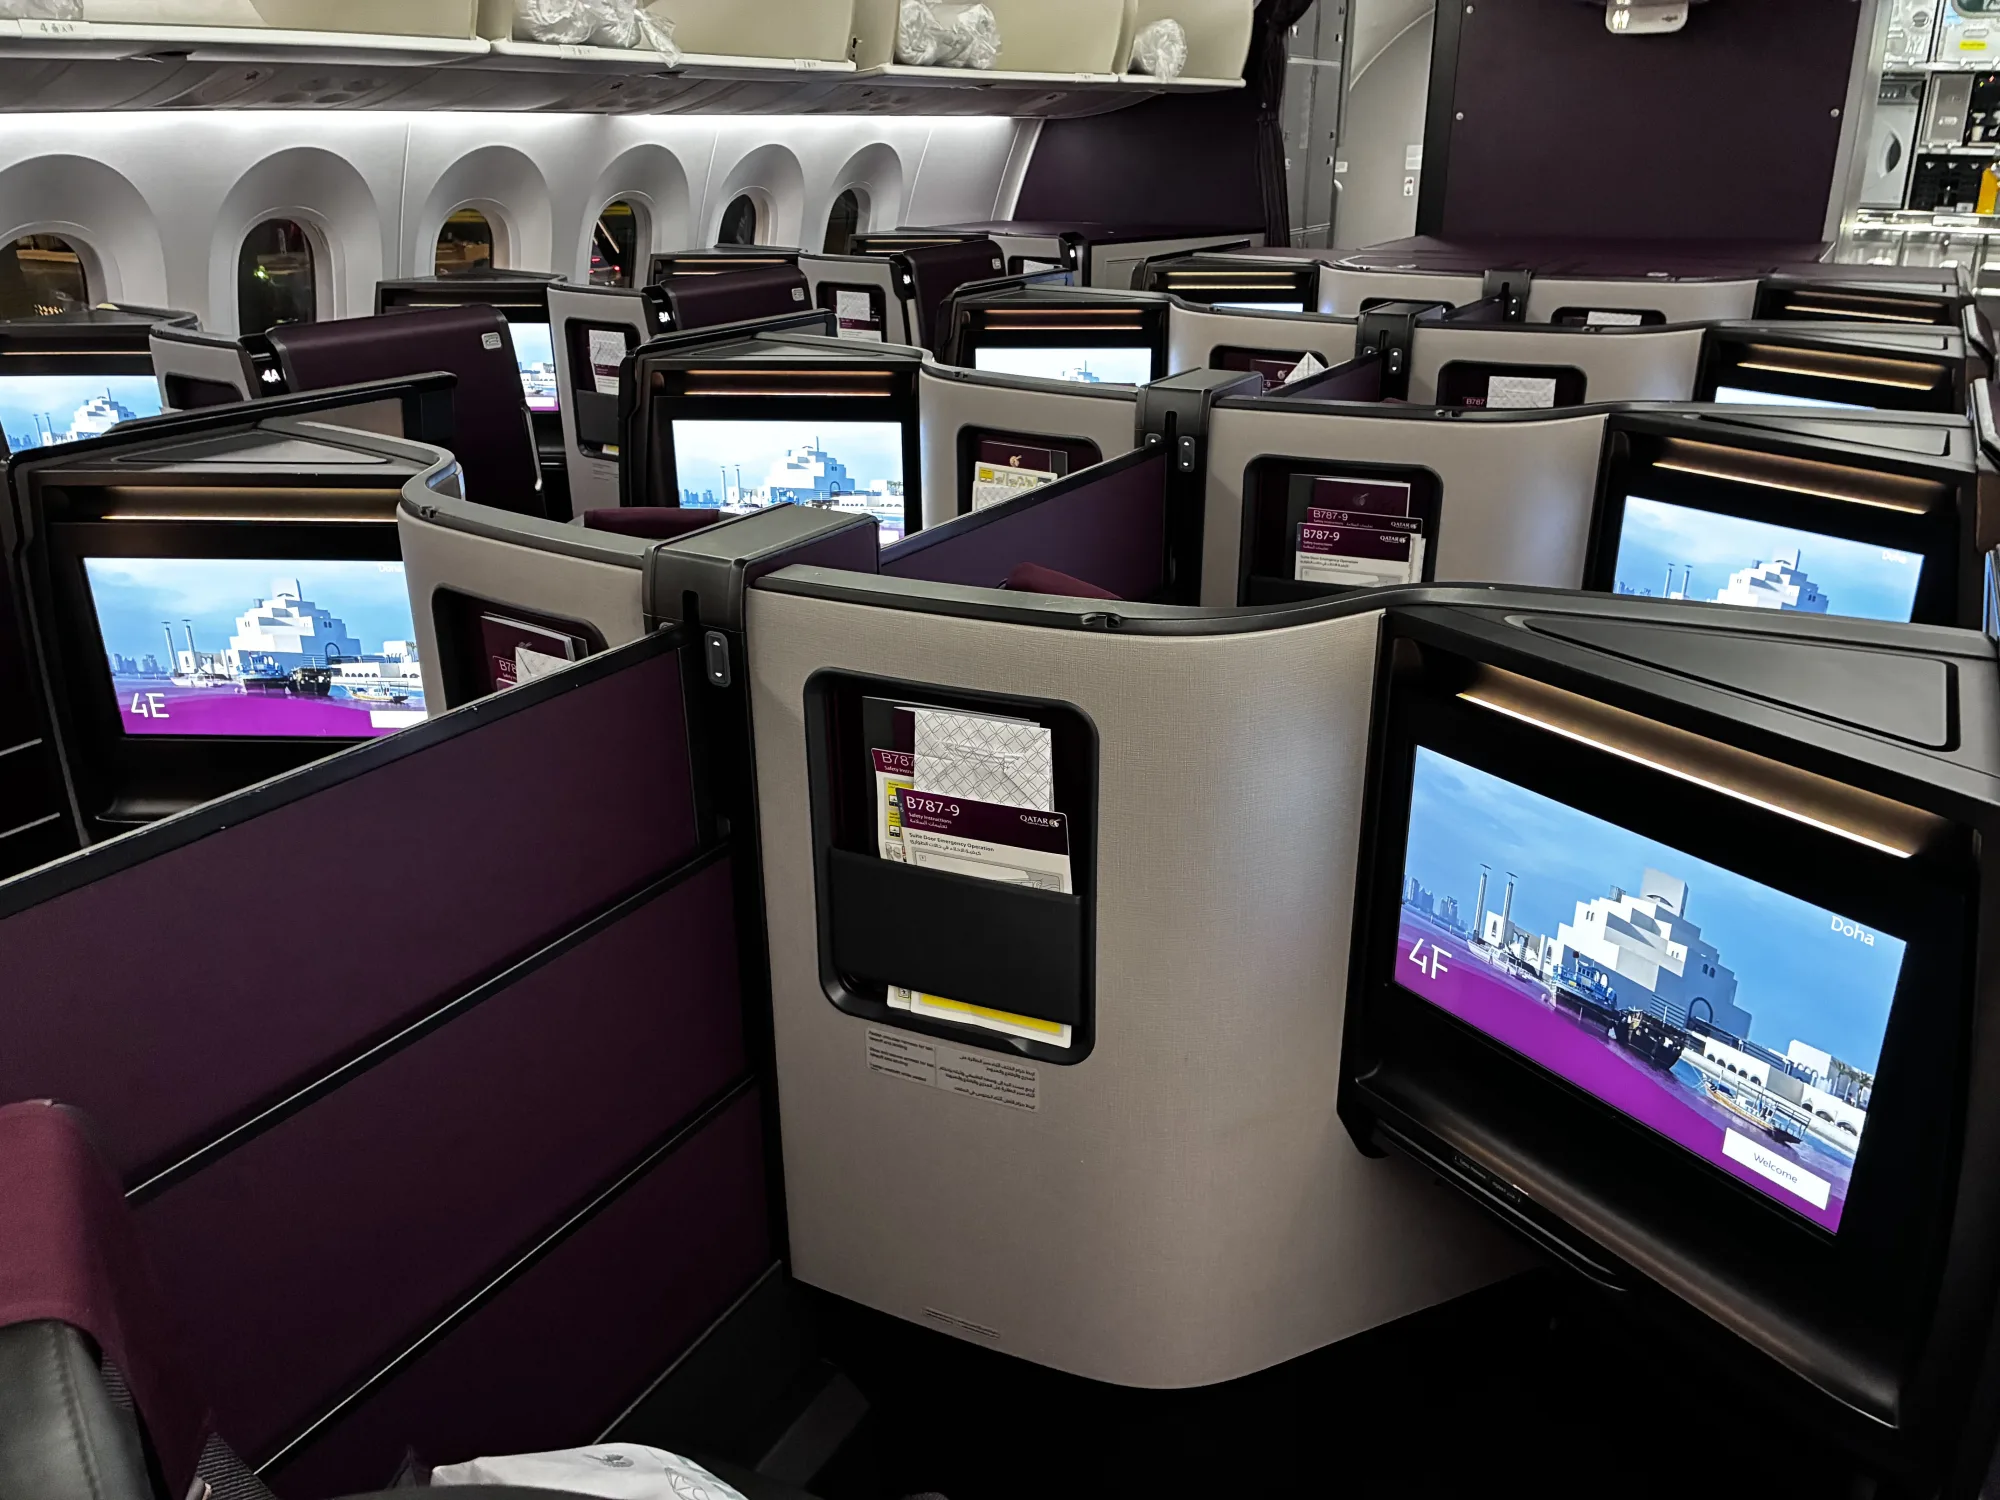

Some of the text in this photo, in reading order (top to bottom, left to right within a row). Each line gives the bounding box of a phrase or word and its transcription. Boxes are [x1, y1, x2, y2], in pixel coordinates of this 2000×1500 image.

[261, 368, 281, 383] 4A
[1313, 509, 1348, 521] B787-9
[1303, 529, 1340, 541] B787-9
[130, 692, 170, 718] 4E
[884, 765, 899, 773] Safety
[906, 795, 960, 817] B787-9
[908, 812, 923, 820] Safety
[923, 813, 952, 824] Instructions
[1019, 814, 1049, 825] QATAR
[937, 836, 966, 848] Emergency
[967, 842, 994, 852] Operation
[1831, 915, 1875, 947] Doha
[1408, 937, 1453, 980] 4F
[1752, 1150, 1799, 1184] Welcome
